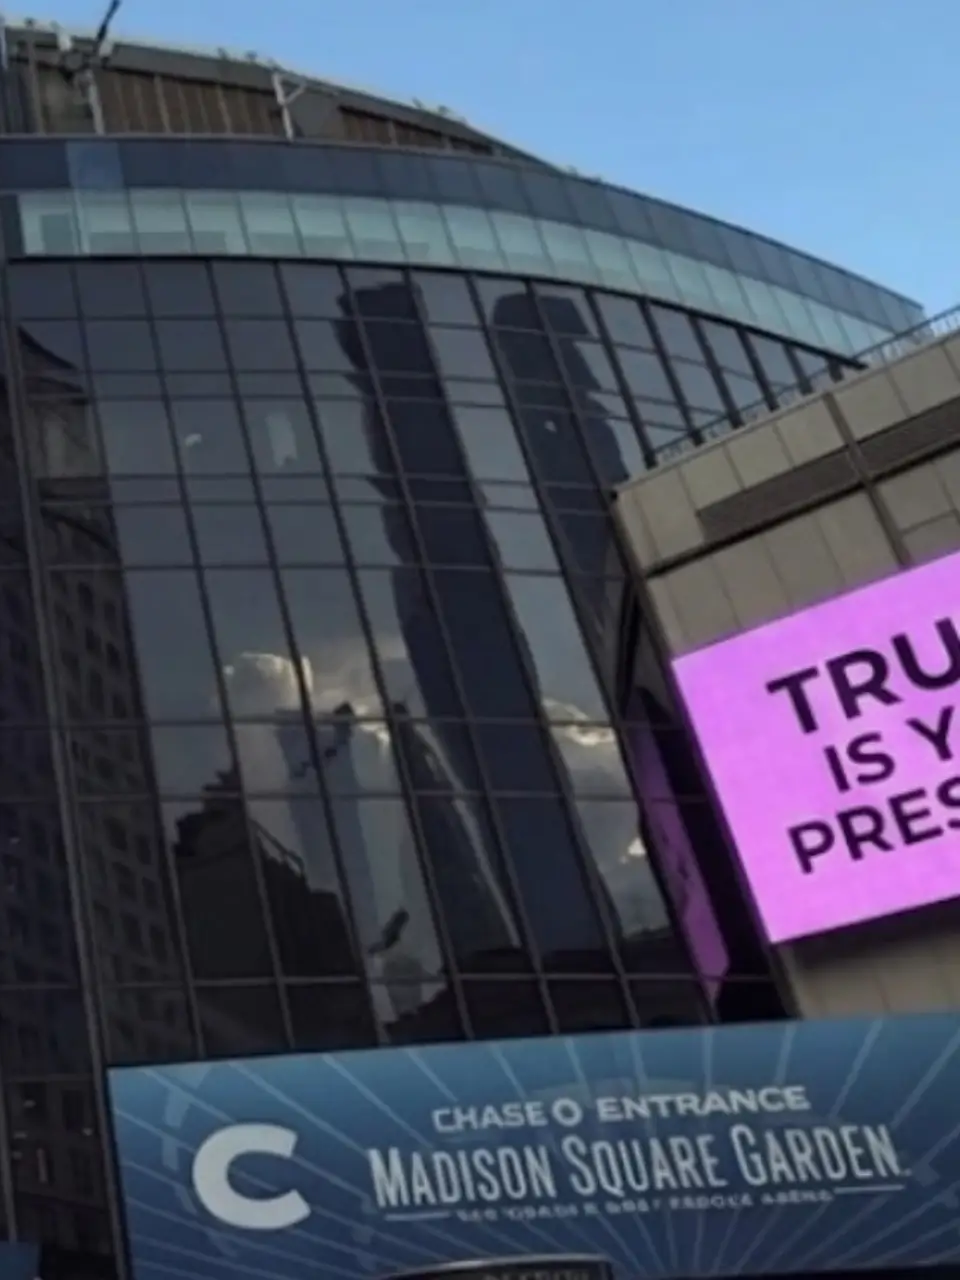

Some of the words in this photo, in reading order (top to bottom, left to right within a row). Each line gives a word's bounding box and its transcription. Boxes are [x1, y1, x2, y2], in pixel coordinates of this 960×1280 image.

[824, 732, 895, 793] IS
[432, 1101, 548, 1133] CHASE
[596, 1085, 810, 1123] ENTRANCE
[368, 1144, 557, 1208] MADISON
[561, 1133, 728, 1198] SQUARE
[730, 1122, 900, 1186] GARDEN
